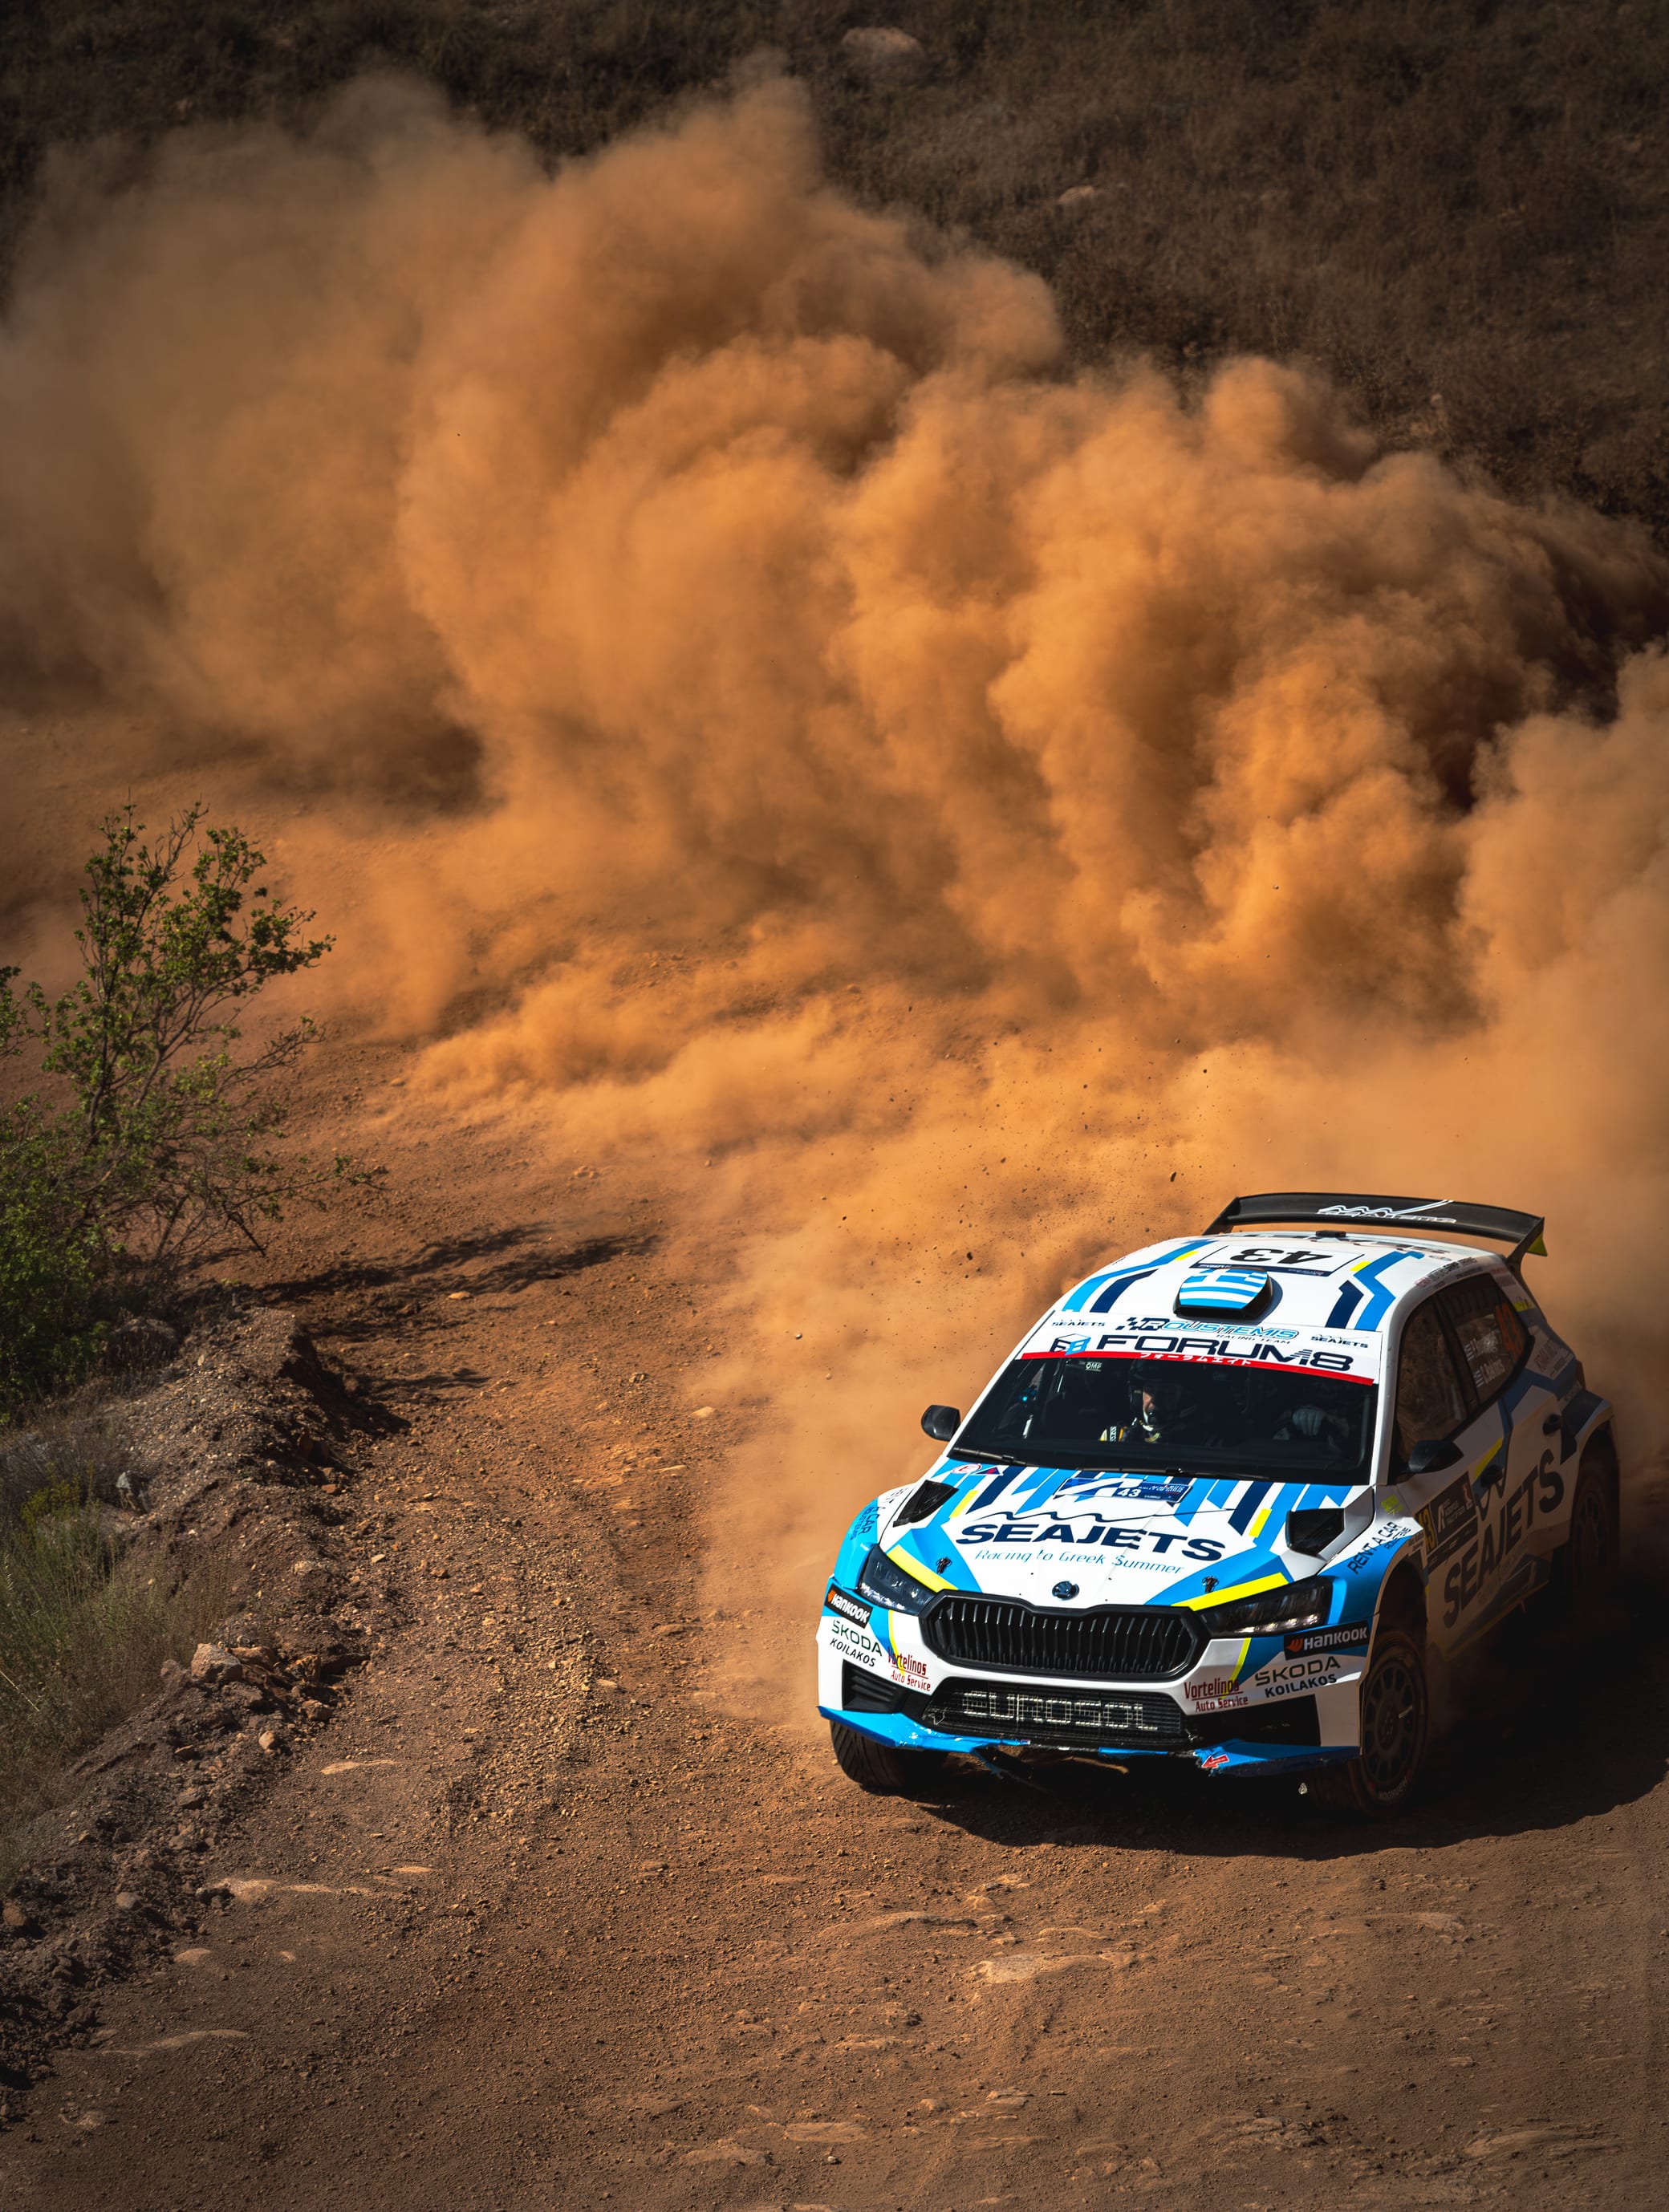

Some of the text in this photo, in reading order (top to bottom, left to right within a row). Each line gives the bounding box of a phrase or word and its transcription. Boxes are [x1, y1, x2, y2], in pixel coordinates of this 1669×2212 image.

[1230, 1248, 1333, 1265] 43
[1096, 1334, 1354, 1372] FORUM8
[1310, 1335, 1369, 1349] SEAJETS
[1140, 1352, 1252, 1366] フォーラムエイト
[1117, 1488, 1141, 1498] 43
[956, 1524, 1225, 1561] SEAJETS
[1347, 1542, 1377, 1575] RENT
[1371, 1536, 1383, 1545] A
[1377, 1521, 1402, 1539] CAR
[1444, 1448, 1565, 1629] SEAJETS
[976, 1548, 1184, 1574] Racing to Greek Summer
[830, 1638, 876, 1667] KOILAKOS
[887, 1646, 928, 1676] Vortelinos
[891, 1671, 931, 1692] Auto Service
[1184, 1678, 1241, 1699] Vortelinos
[1265, 1674, 1338, 1699] KOILAKOS
[963, 1690, 1158, 1731] EUROSOL
[1195, 1695, 1249, 1713] Auto Service
